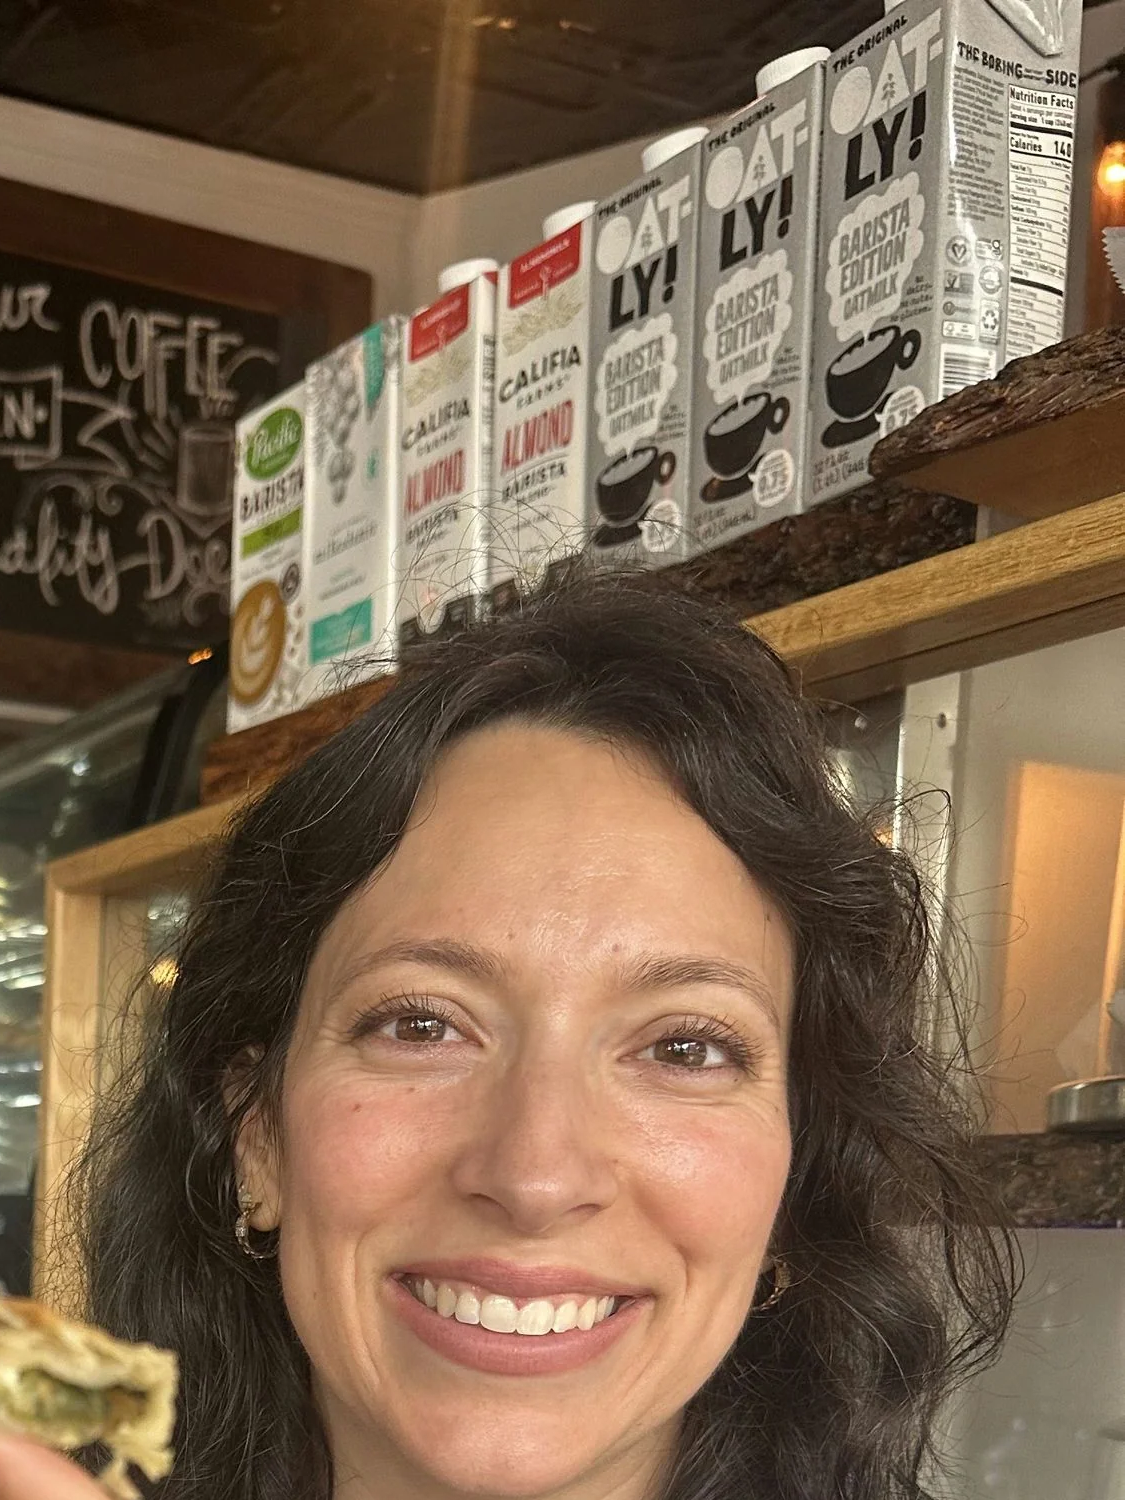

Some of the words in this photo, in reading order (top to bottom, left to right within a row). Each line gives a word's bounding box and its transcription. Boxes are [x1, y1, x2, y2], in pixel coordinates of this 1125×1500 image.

[832, 53, 855, 74] THE
[857, 14, 909, 57] ORIGINAL
[957, 41, 980, 61] THE
[981, 51, 1023, 79] BORING
[1045, 69, 1077, 88] SIDE
[1009, 87, 1048, 105] Nutrition
[1050, 95, 1074, 109] Facts
[845, 90, 927, 201] LY!
[1009, 136, 1043, 153] Calories
[719, 174, 794, 272] LY!
[839, 197, 911, 267] BARISTA
[609, 244, 678, 333] LY!
[840, 231, 908, 296] EDITION
[715, 273, 779, 333] BARISTA
[843, 272, 900, 321] OATMILK
[80, 299, 247, 417] COFFEE
[716, 304, 775, 361] EDITION
[499, 345, 581, 403] CALIFIA
[402, 398, 470, 450] CALIFIA
[502, 400, 574, 476] ALMOND
[137, 507, 232, 600] Doe
